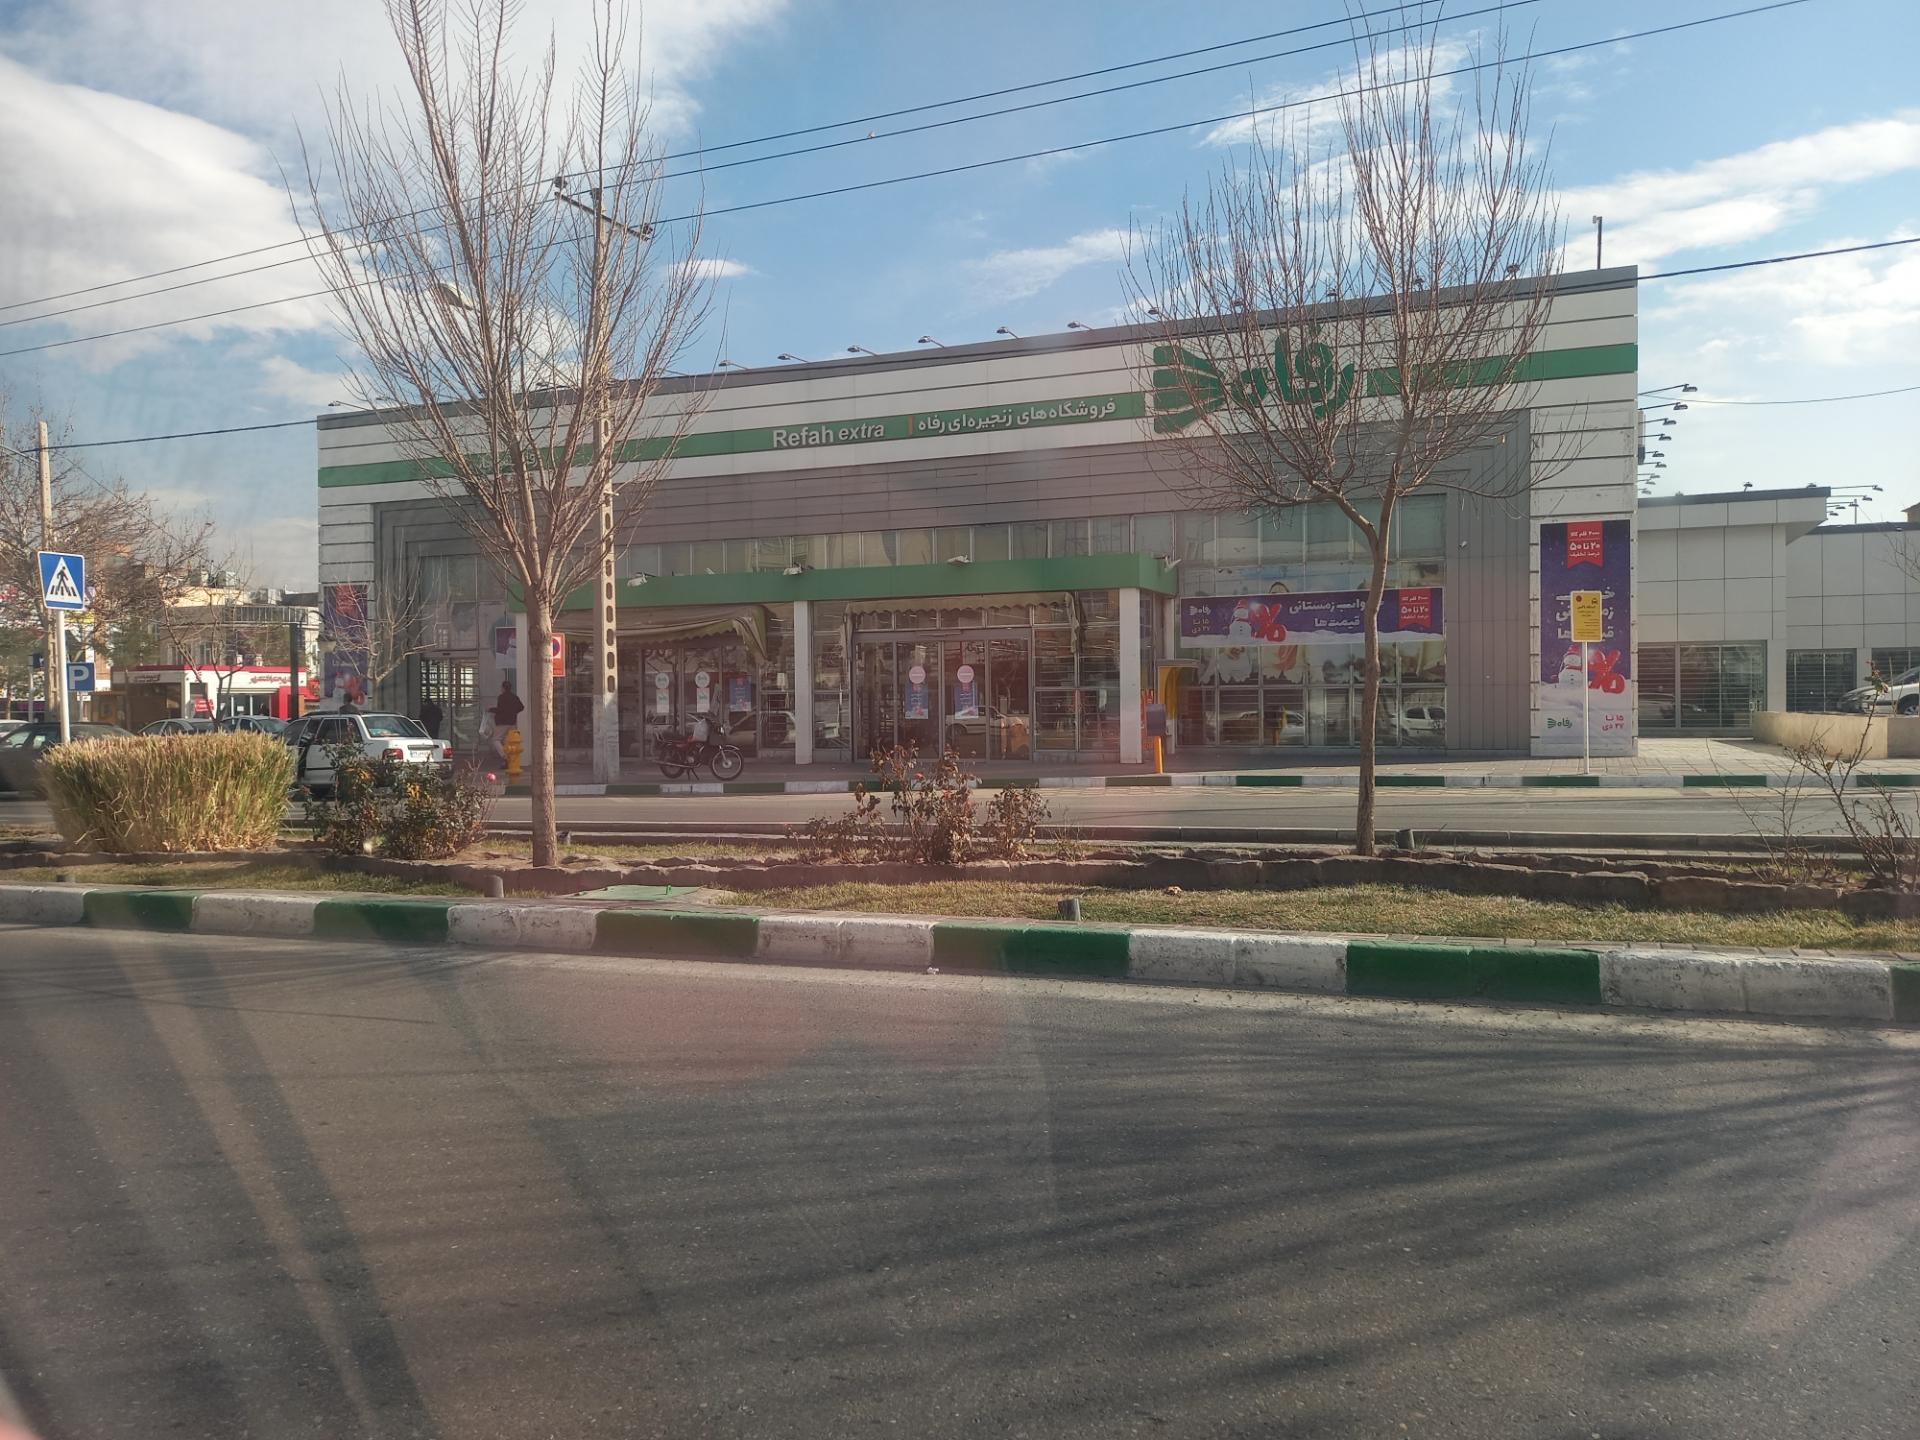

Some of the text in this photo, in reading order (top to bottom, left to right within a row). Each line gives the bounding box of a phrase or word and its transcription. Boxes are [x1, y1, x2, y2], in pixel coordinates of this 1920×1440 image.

[918, 414, 946, 434] رفاه
[772, 423, 885, 448] Refah extra
[1569, 541, 1582, 551] ۵۰
[1583, 542, 1590, 550] تا
[1289, 601, 1335, 614] زمستانی
[69, 665, 90, 690] P
[1557, 717, 1573, 729] رفاه
[1601, 722, 1614, 732] دی
